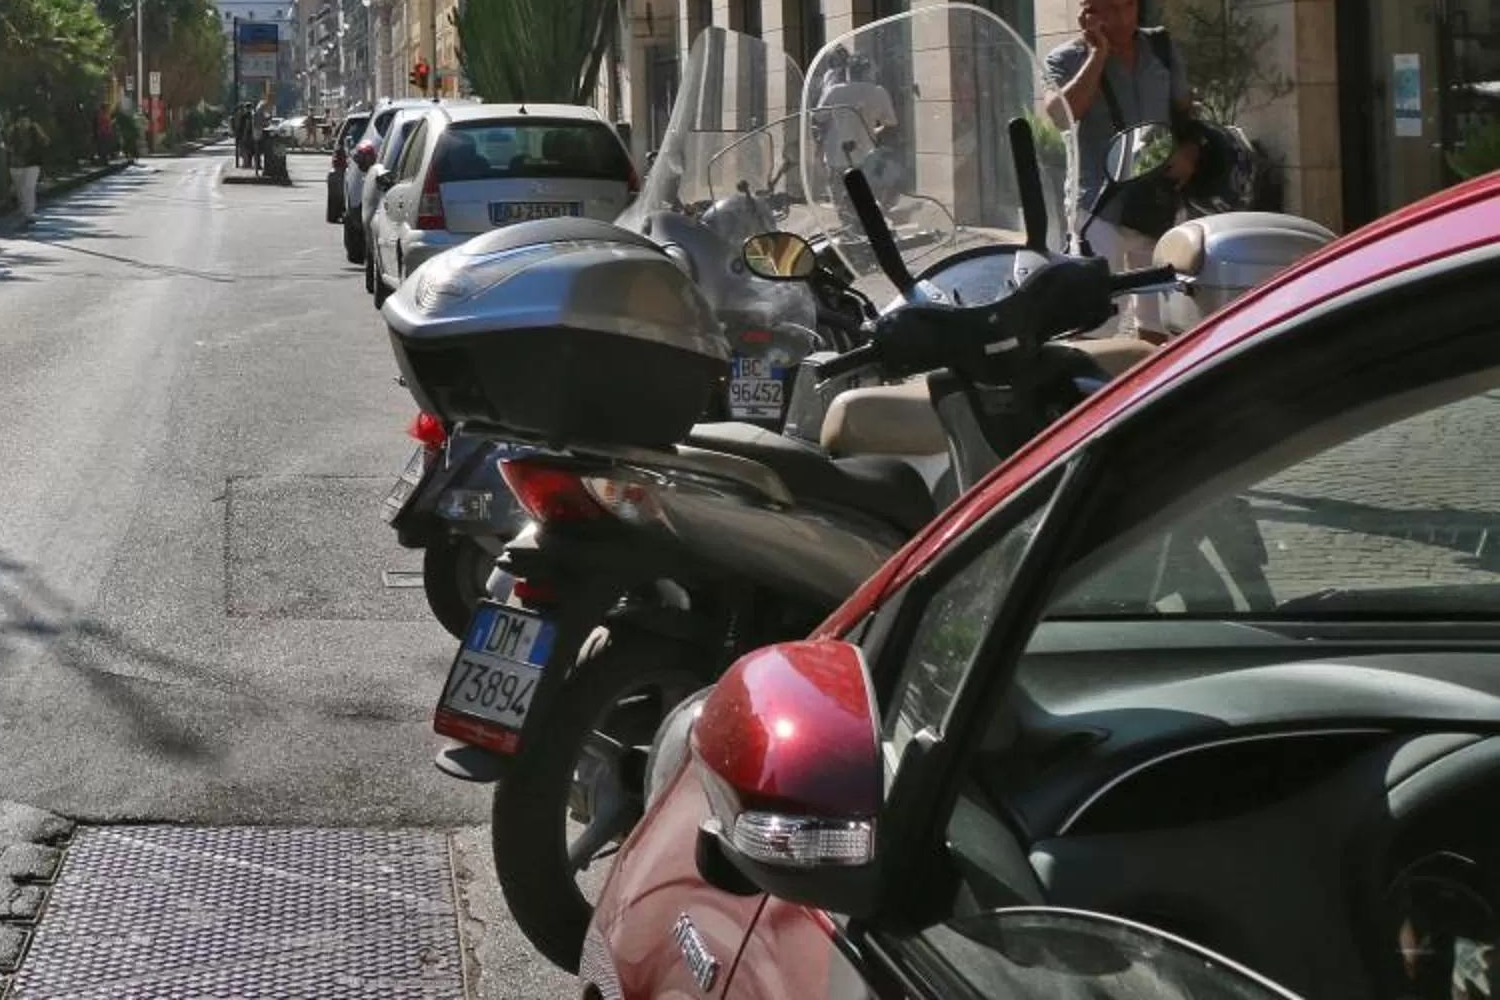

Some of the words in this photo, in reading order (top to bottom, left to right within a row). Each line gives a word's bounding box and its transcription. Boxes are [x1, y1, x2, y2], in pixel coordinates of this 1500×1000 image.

[741, 359, 762, 377] BC
[731, 383, 781, 402] 96452
[486, 614, 526, 658] DM
[451, 660, 535, 718] 73894
